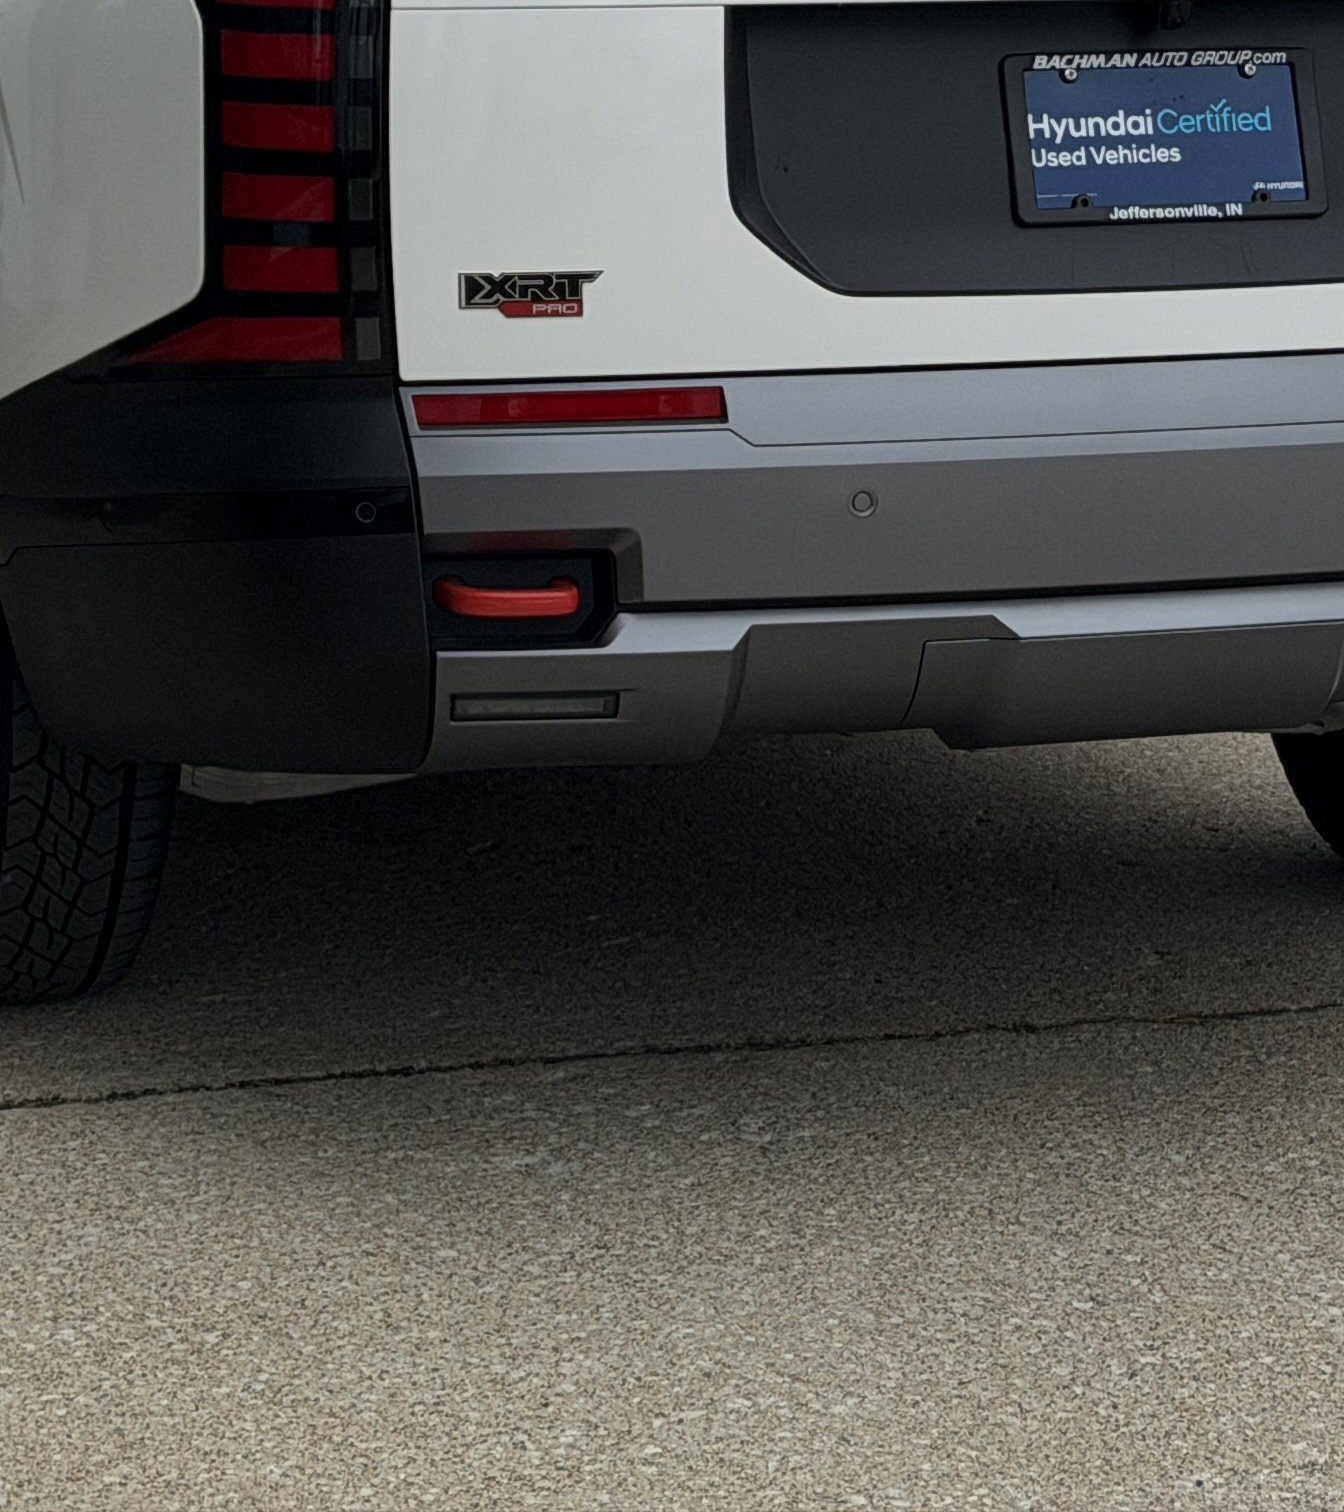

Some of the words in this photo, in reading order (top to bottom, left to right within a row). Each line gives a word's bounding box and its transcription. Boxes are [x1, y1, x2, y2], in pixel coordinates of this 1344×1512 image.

[1032, 53, 1138, 70] BACHMAN
[1138, 51, 1188, 67] AUTO
[1027, 108, 1154, 144] Hyundai
[1156, 99, 1272, 135] Certified
[1031, 146, 1087, 168] Used
[1090, 143, 1182, 165] Vehicles
[1109, 203, 1223, 220] Jeffersonville,
[1225, 202, 1243, 217] IN
[463, 271, 604, 306] XRT
[532, 303, 578, 315] PRO
